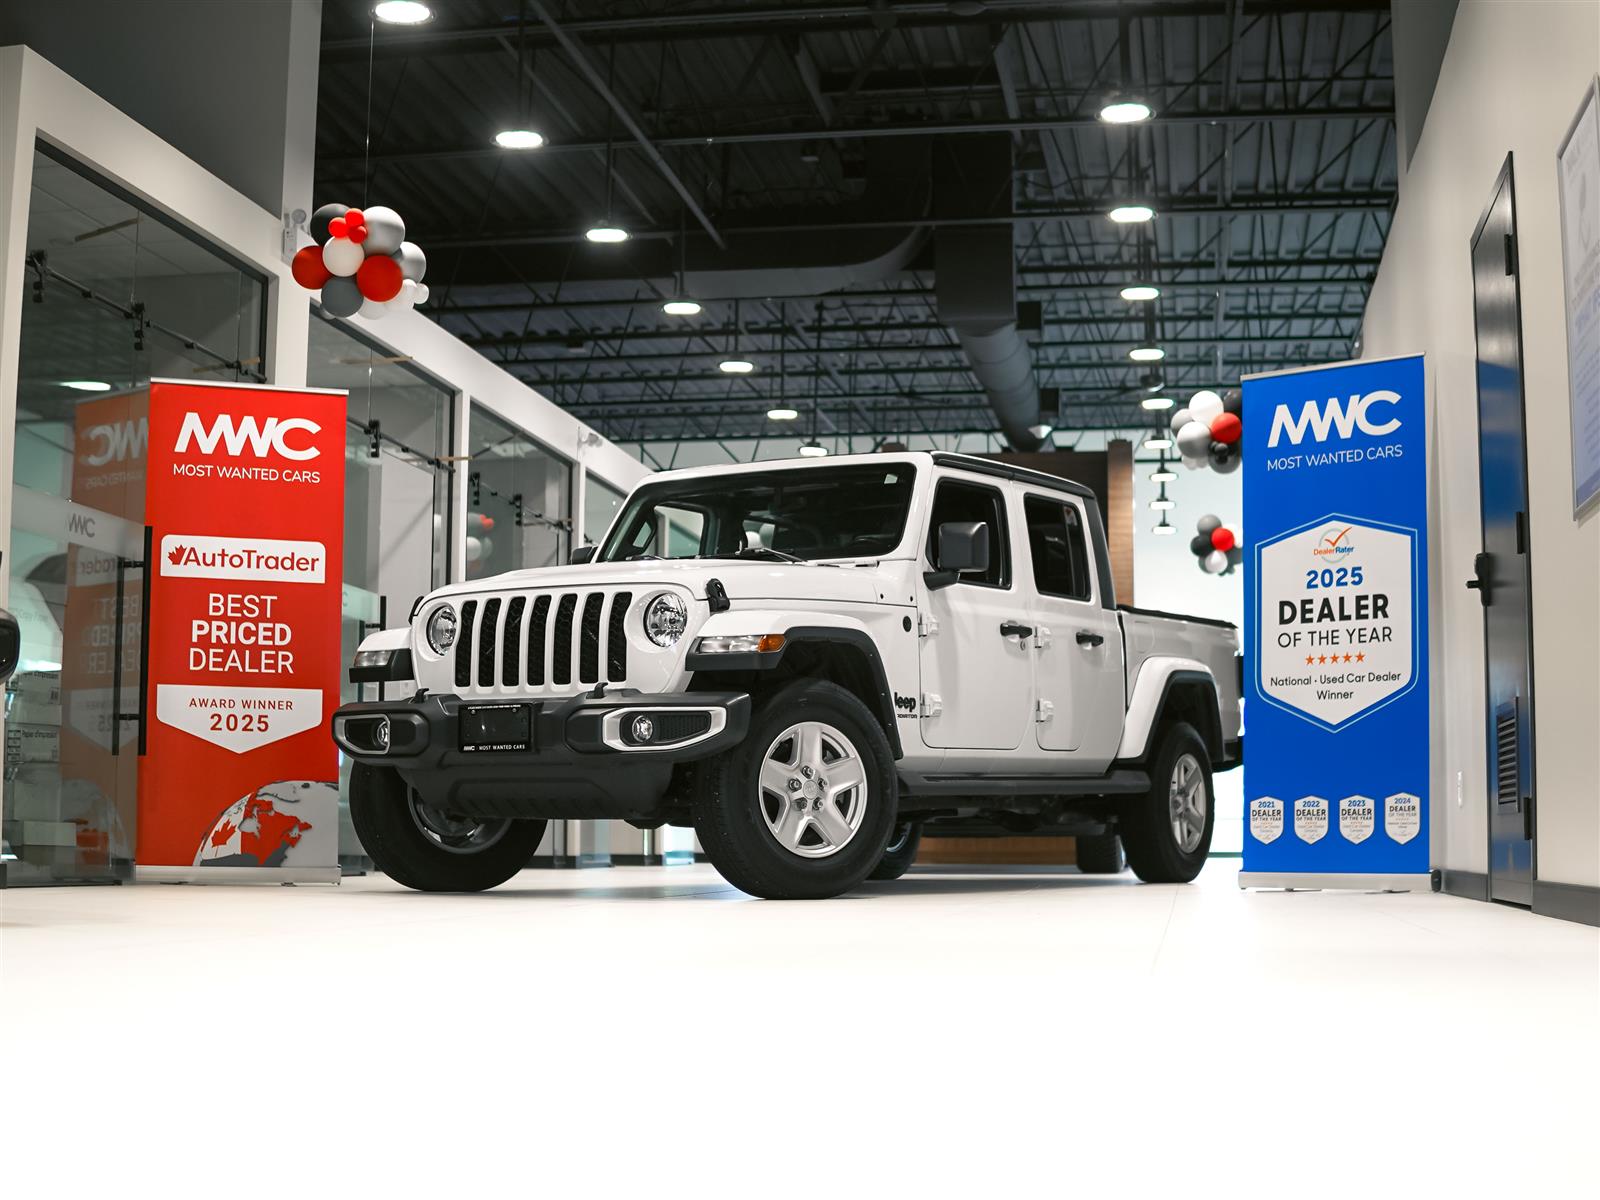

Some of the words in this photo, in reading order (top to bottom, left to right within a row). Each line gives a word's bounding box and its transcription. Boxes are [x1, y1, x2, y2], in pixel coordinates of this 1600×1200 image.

[1267, 390, 1402, 448] MWC
[174, 411, 322, 461] MWC
[1267, 455, 1302, 471] MOST
[1306, 449, 1364, 467] WANTED
[1366, 444, 1403, 460] CARS
[173, 463, 214, 478] MOST
[216, 465, 279, 481] WANTED
[282, 469, 321, 483] CARS
[183, 546, 320, 572] AutoTrader
[1313, 546, 1355, 556] DealerRater
[1306, 566, 1364, 589] 2025
[208, 592, 278, 619] BEST
[1278, 593, 1390, 625] DEALER
[191, 619, 292, 646] PRICED
[1277, 631, 1302, 648] OF
[1307, 629, 1340, 647] THE
[1345, 626, 1393, 645] YEAR
[189, 647, 294, 674] DEALER
[1270, 676, 1312, 687] National
[1320, 673, 1345, 685] Used
[1347, 673, 1365, 684] Car
[1368, 671, 1401, 682] Dealer
[189, 698, 236, 709] AWARD
[241, 699, 294, 711] WINNER
[1316, 690, 1354, 701] Winner
[209, 713, 270, 732] 2025
[1252, 809, 1282, 817] DEALER
[1302, 800, 1320, 808] 2022
[1341, 808, 1372, 816] DEALER
[1347, 800, 1366, 808] 2023
